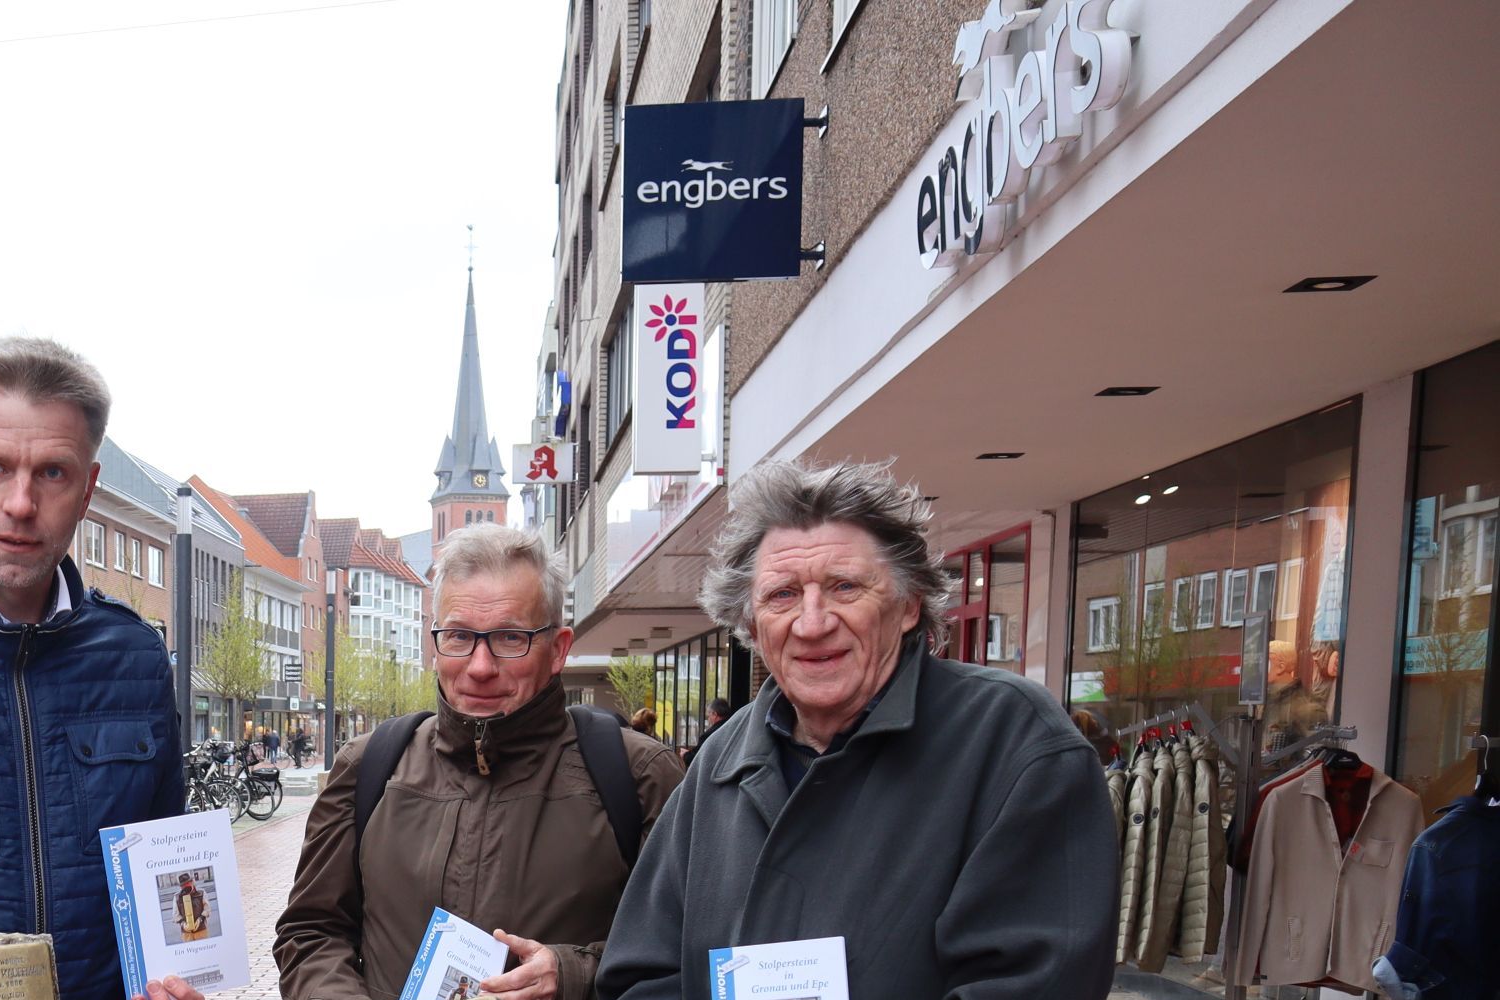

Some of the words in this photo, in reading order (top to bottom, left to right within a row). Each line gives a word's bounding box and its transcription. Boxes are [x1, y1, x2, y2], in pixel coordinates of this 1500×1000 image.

[917, 0, 1108, 269] engbers
[637, 171, 788, 209] engbers
[151, 830, 208, 846] Stolpersteine
[176, 845, 185, 853] in
[110, 843, 125, 891] ZeitWORT
[146, 857, 180, 870] Gronau
[183, 852, 201, 864] und
[203, 850, 220, 862] Epe
[187, 943, 217, 954] Wegweiser
[459, 934, 492, 958] Stolpersteine
[446, 951, 468, 967] Gronau
[469, 962, 482, 974] und
[758, 957, 819, 971] Stolpersteine
[751, 984, 787, 994] Gronau
[790, 980, 809, 990] und
[812, 979, 829, 989] Epe
